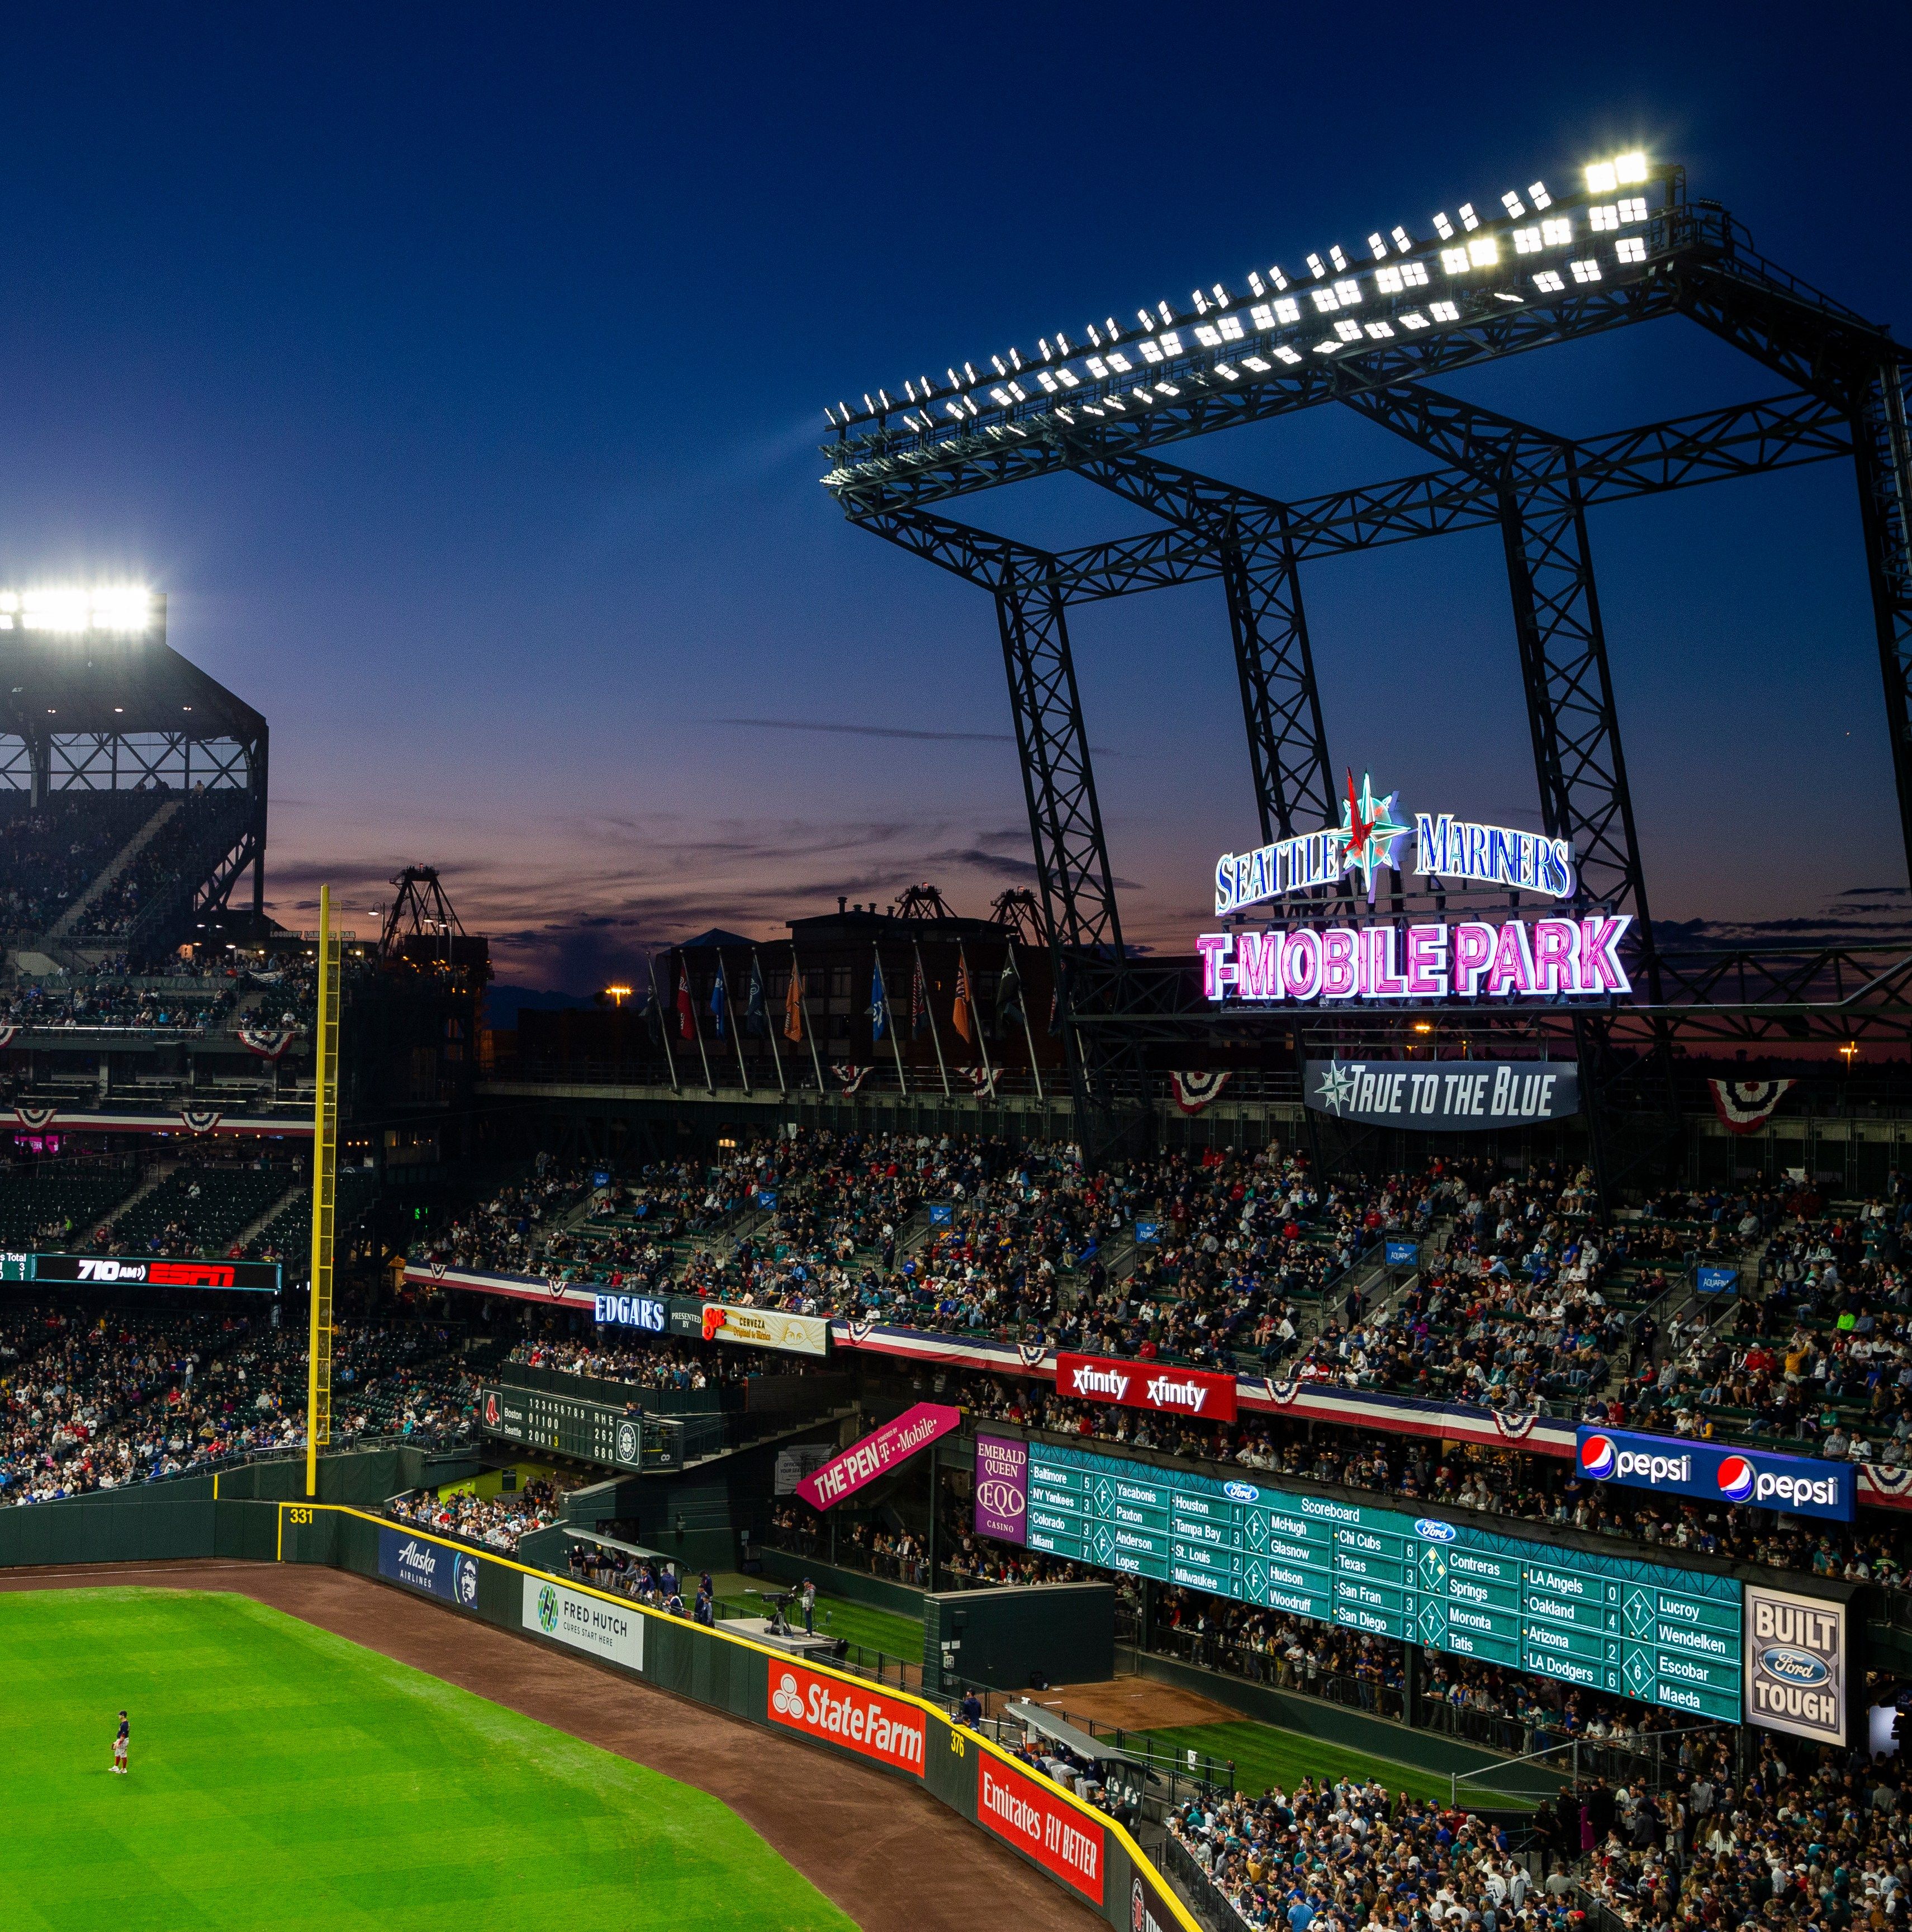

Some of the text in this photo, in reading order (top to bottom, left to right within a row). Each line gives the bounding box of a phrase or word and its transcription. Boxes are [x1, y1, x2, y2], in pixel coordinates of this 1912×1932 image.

[1215, 813, 1570, 916] SEATTLE MARINERS
[1195, 915, 1634, 1001] T-MOBILE PARK
[1348, 1065, 1557, 1116] TRUE TO THE BLUE
[6, 1252, 26, 1262] Total
[19, 1262, 25, 1272] 3
[20, 1271, 24, 1281] 1
[77, 1259, 235, 1287] 710 AM ESPN
[671, 1312, 701, 1324] PRESENTED
[739, 1317, 766, 1329] CERVEZA
[1073, 1365, 1208, 1412] xfinity xfinity
[529, 1398, 613, 1426] 1 2 3 4 5 6 7 8 9 R H E
[504, 1407, 613, 1443] Boston 0 1 1 0 0 2 6 2
[504, 1424, 613, 1460] Seattle 2 0 0 1 3 6 8 0
[979, 1442, 1026, 1465] EMERALD
[985, 1459, 1018, 1478] QUEEN
[1034, 1466, 1090, 1489] Baltimore 5
[1617, 1451, 1690, 1484] pepsi
[814, 1464, 847, 1504] THE
[1100, 1490, 1107, 1503] F
[1117, 1483, 1156, 1504] Yacabonis
[1230, 1483, 1252, 1500] Ford
[1757, 1473, 1837, 1507] pepsi
[983, 1483, 1023, 1517] EQC
[1033, 1488, 1089, 1512] NY Yankees 3
[1175, 1495, 1240, 1521] Houston 1
[1301, 1498, 1360, 1523] Scoreboard
[290, 1508, 312, 1524] 331
[986, 1520, 1014, 1533] CASINO
[1033, 1512, 1089, 1536] Colorado 3
[1116, 1505, 1143, 1523] Paxton
[1271, 1515, 1307, 1536] McHugh
[1116, 1531, 1152, 1551] Anderson
[1175, 1518, 1240, 1545] Tampa Bay 3
[1252, 1522, 1259, 1536] F
[1422, 1521, 1448, 1539] Ford
[1032, 1533, 1089, 1558] Miami 7
[1100, 1538, 1106, 1551] F
[1270, 1540, 1310, 1561] Glasnow
[1339, 1530, 1413, 1557] Chi Cubs 6
[398, 1541, 436, 1575] Alaska
[1116, 1553, 1140, 1571] Lopez
[1175, 1544, 1239, 1571] St. Louis 2
[1339, 1554, 1413, 1583] Texas 3
[1429, 1560, 1435, 1575] 7
[1450, 1552, 1501, 1576] Contreras
[400, 1569, 432, 1589] AIRLINES
[1175, 1568, 1239, 1594] Milwaukee 4
[1251, 1573, 1259, 1588] F
[1270, 1565, 1303, 1586] Hudson
[1530, 1569, 1616, 1601] LA Angels 0
[1270, 1590, 1311, 1613] Woodruff
[1339, 1581, 1413, 1612] San Fran 3
[1449, 1578, 1488, 1602] Springs
[564, 1600, 628, 1637] FRED HUTCH
[1450, 1607, 1492, 1631] Moronta
[1529, 1596, 1616, 1629] Oakland 4
[1634, 1603, 1642, 1621] 7
[1659, 1596, 1700, 1622] Lucroy
[563, 1621, 613, 1647] CURES START HERE
[1339, 1608, 1413, 1637] San Diego 2
[1428, 1615, 1435, 1630] 7
[1756, 1602, 1837, 1652] BUILT
[1449, 1633, 1474, 1652] Tatis
[1529, 1626, 1616, 1660] Arizona 2
[1659, 1624, 1726, 1655] Wendelken
[1529, 1652, 1616, 1688] LA Dodgers 6
[1634, 1664, 1641, 1680] 6
[1659, 1656, 1709, 1682] Escobar
[1775, 1652, 1815, 1679] Ford
[1659, 1684, 1701, 1709] Maeda
[1755, 1680, 1836, 1726] TOUGH
[951, 1730, 965, 1758] 376
[984, 1770, 1098, 1880] Emirates FLY BETTER
